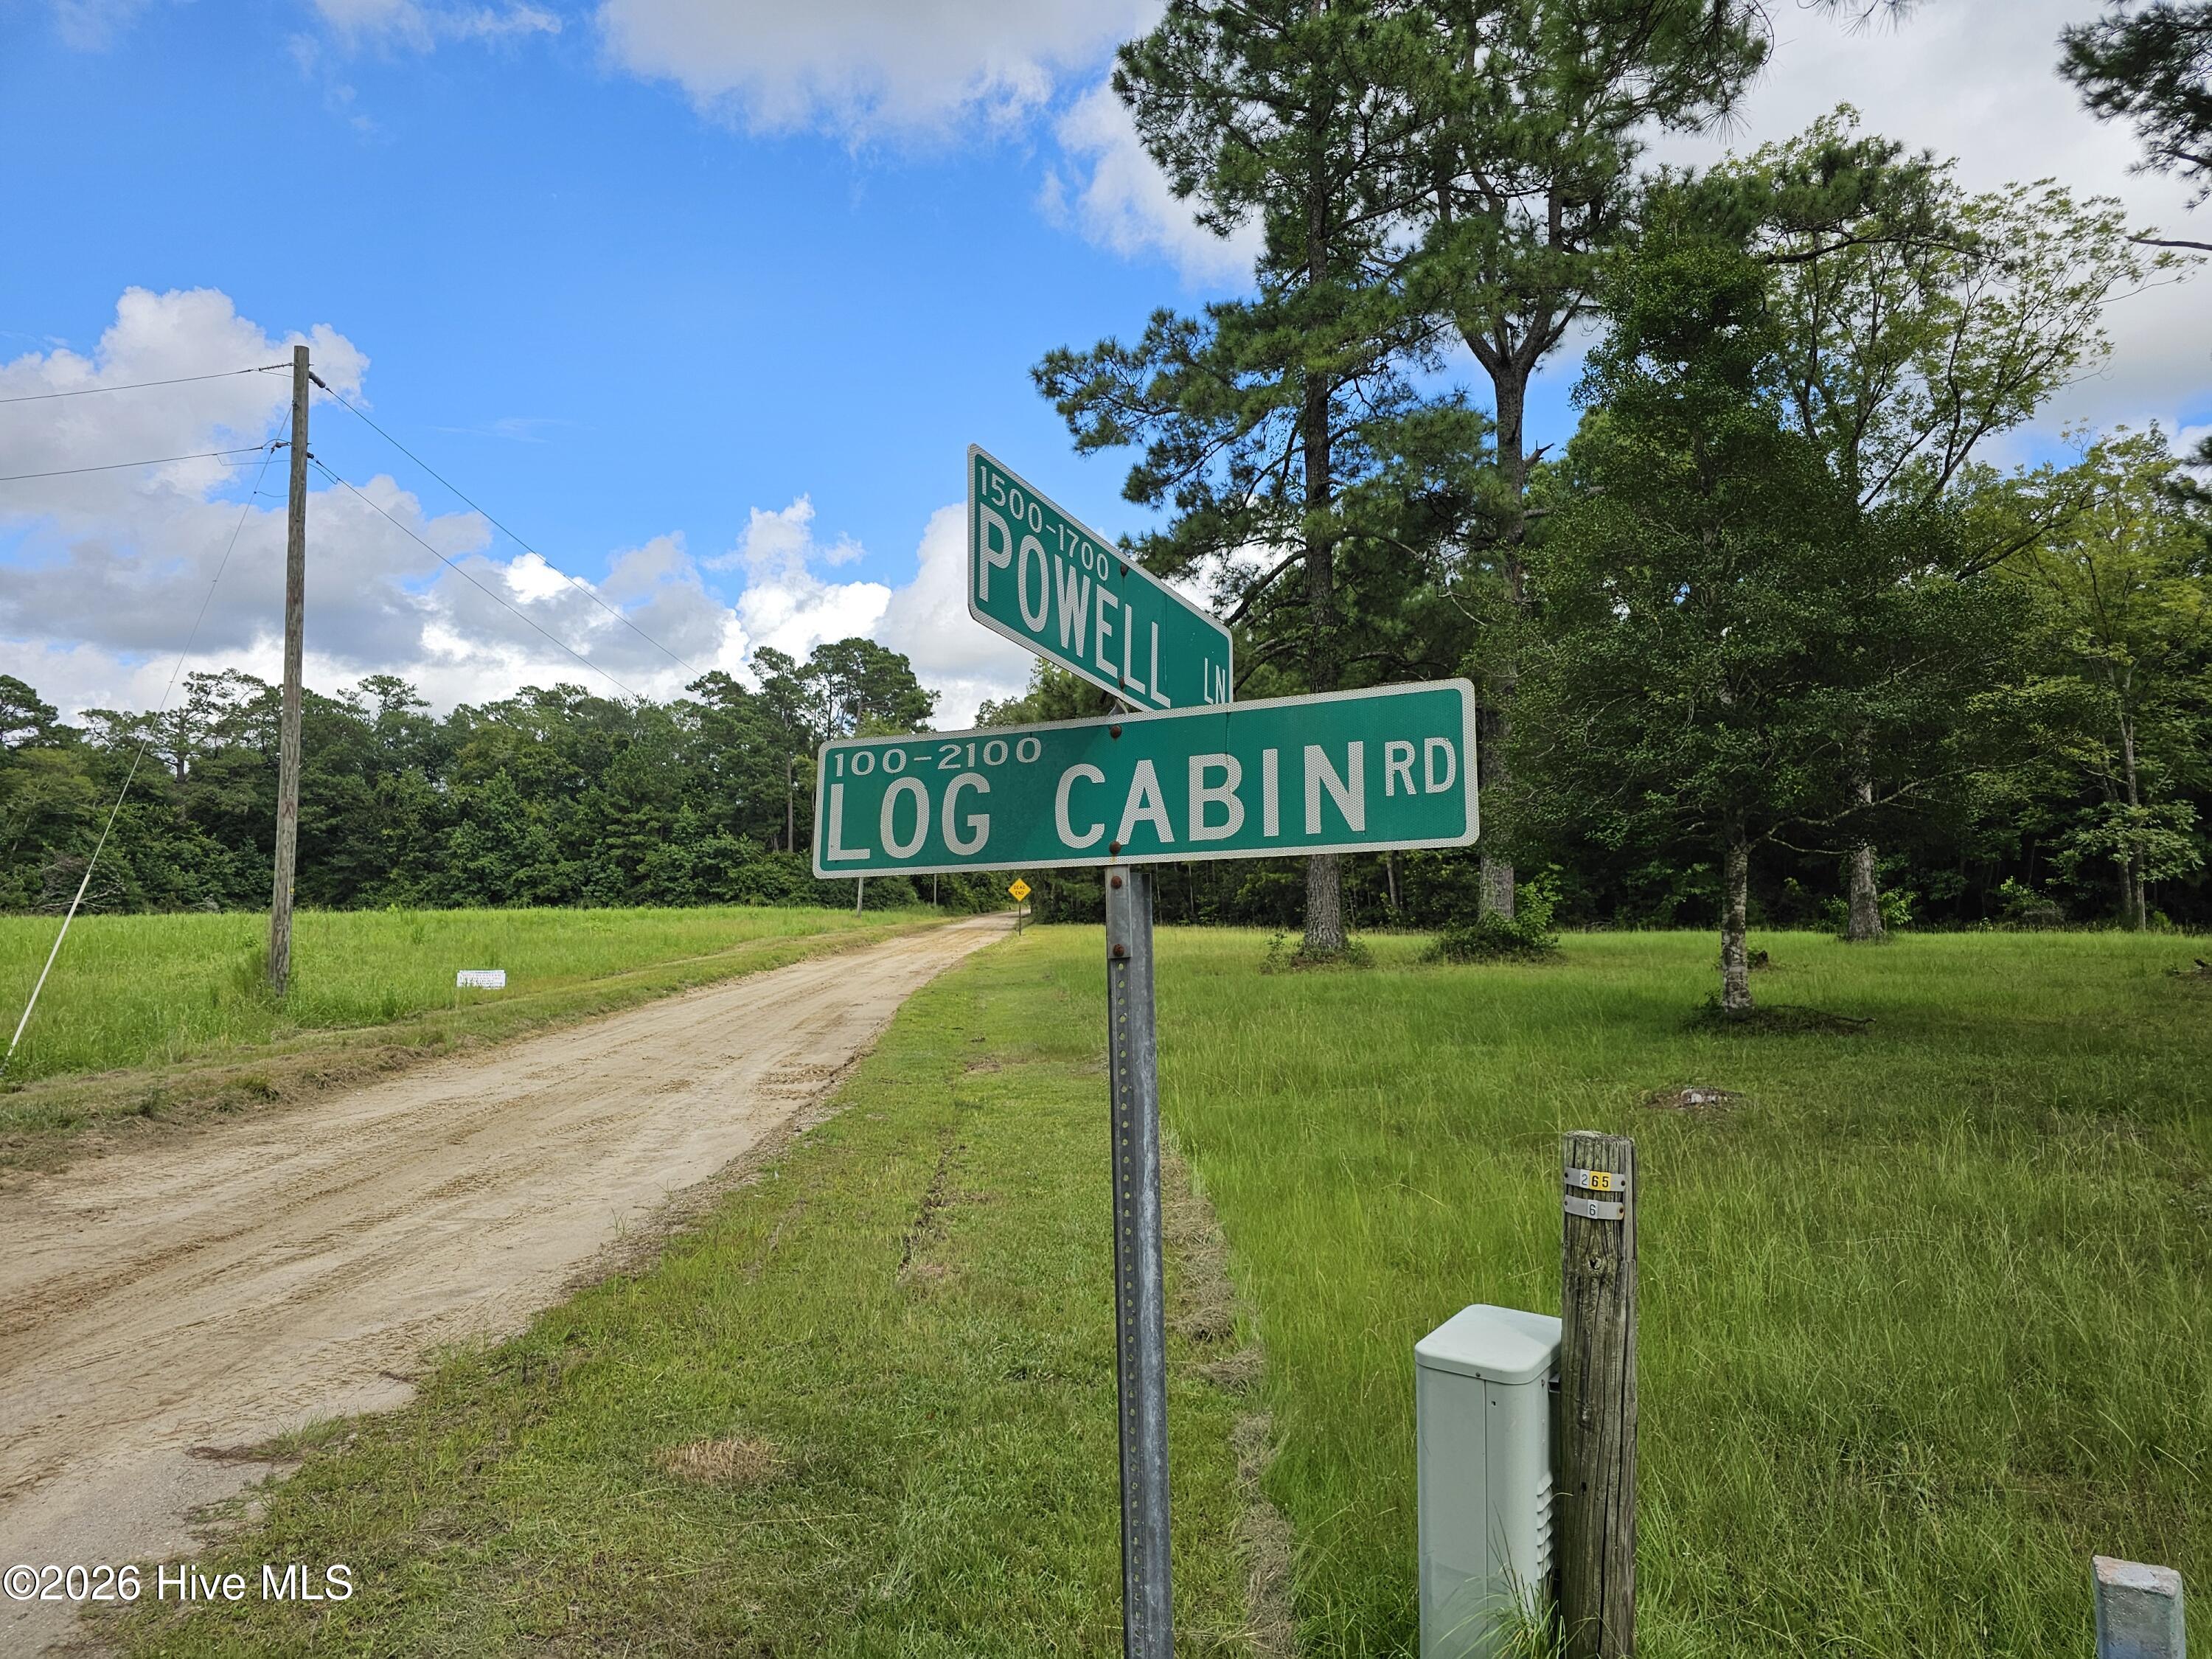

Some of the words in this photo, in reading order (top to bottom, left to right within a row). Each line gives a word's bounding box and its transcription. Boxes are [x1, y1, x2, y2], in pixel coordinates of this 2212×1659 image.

[979, 465, 1109, 582] 1500-1700
[978, 501, 1171, 709] POWELL
[1205, 657, 1225, 704] LN
[834, 737, 1042, 778] 100-2100
[827, 772, 992, 861] LOG
[1054, 740, 1366, 849] CABIN
[1384, 737, 1457, 797] RD
[1581, 1173, 1610, 1188] 265
[1589, 1203, 1596, 1216] 6
